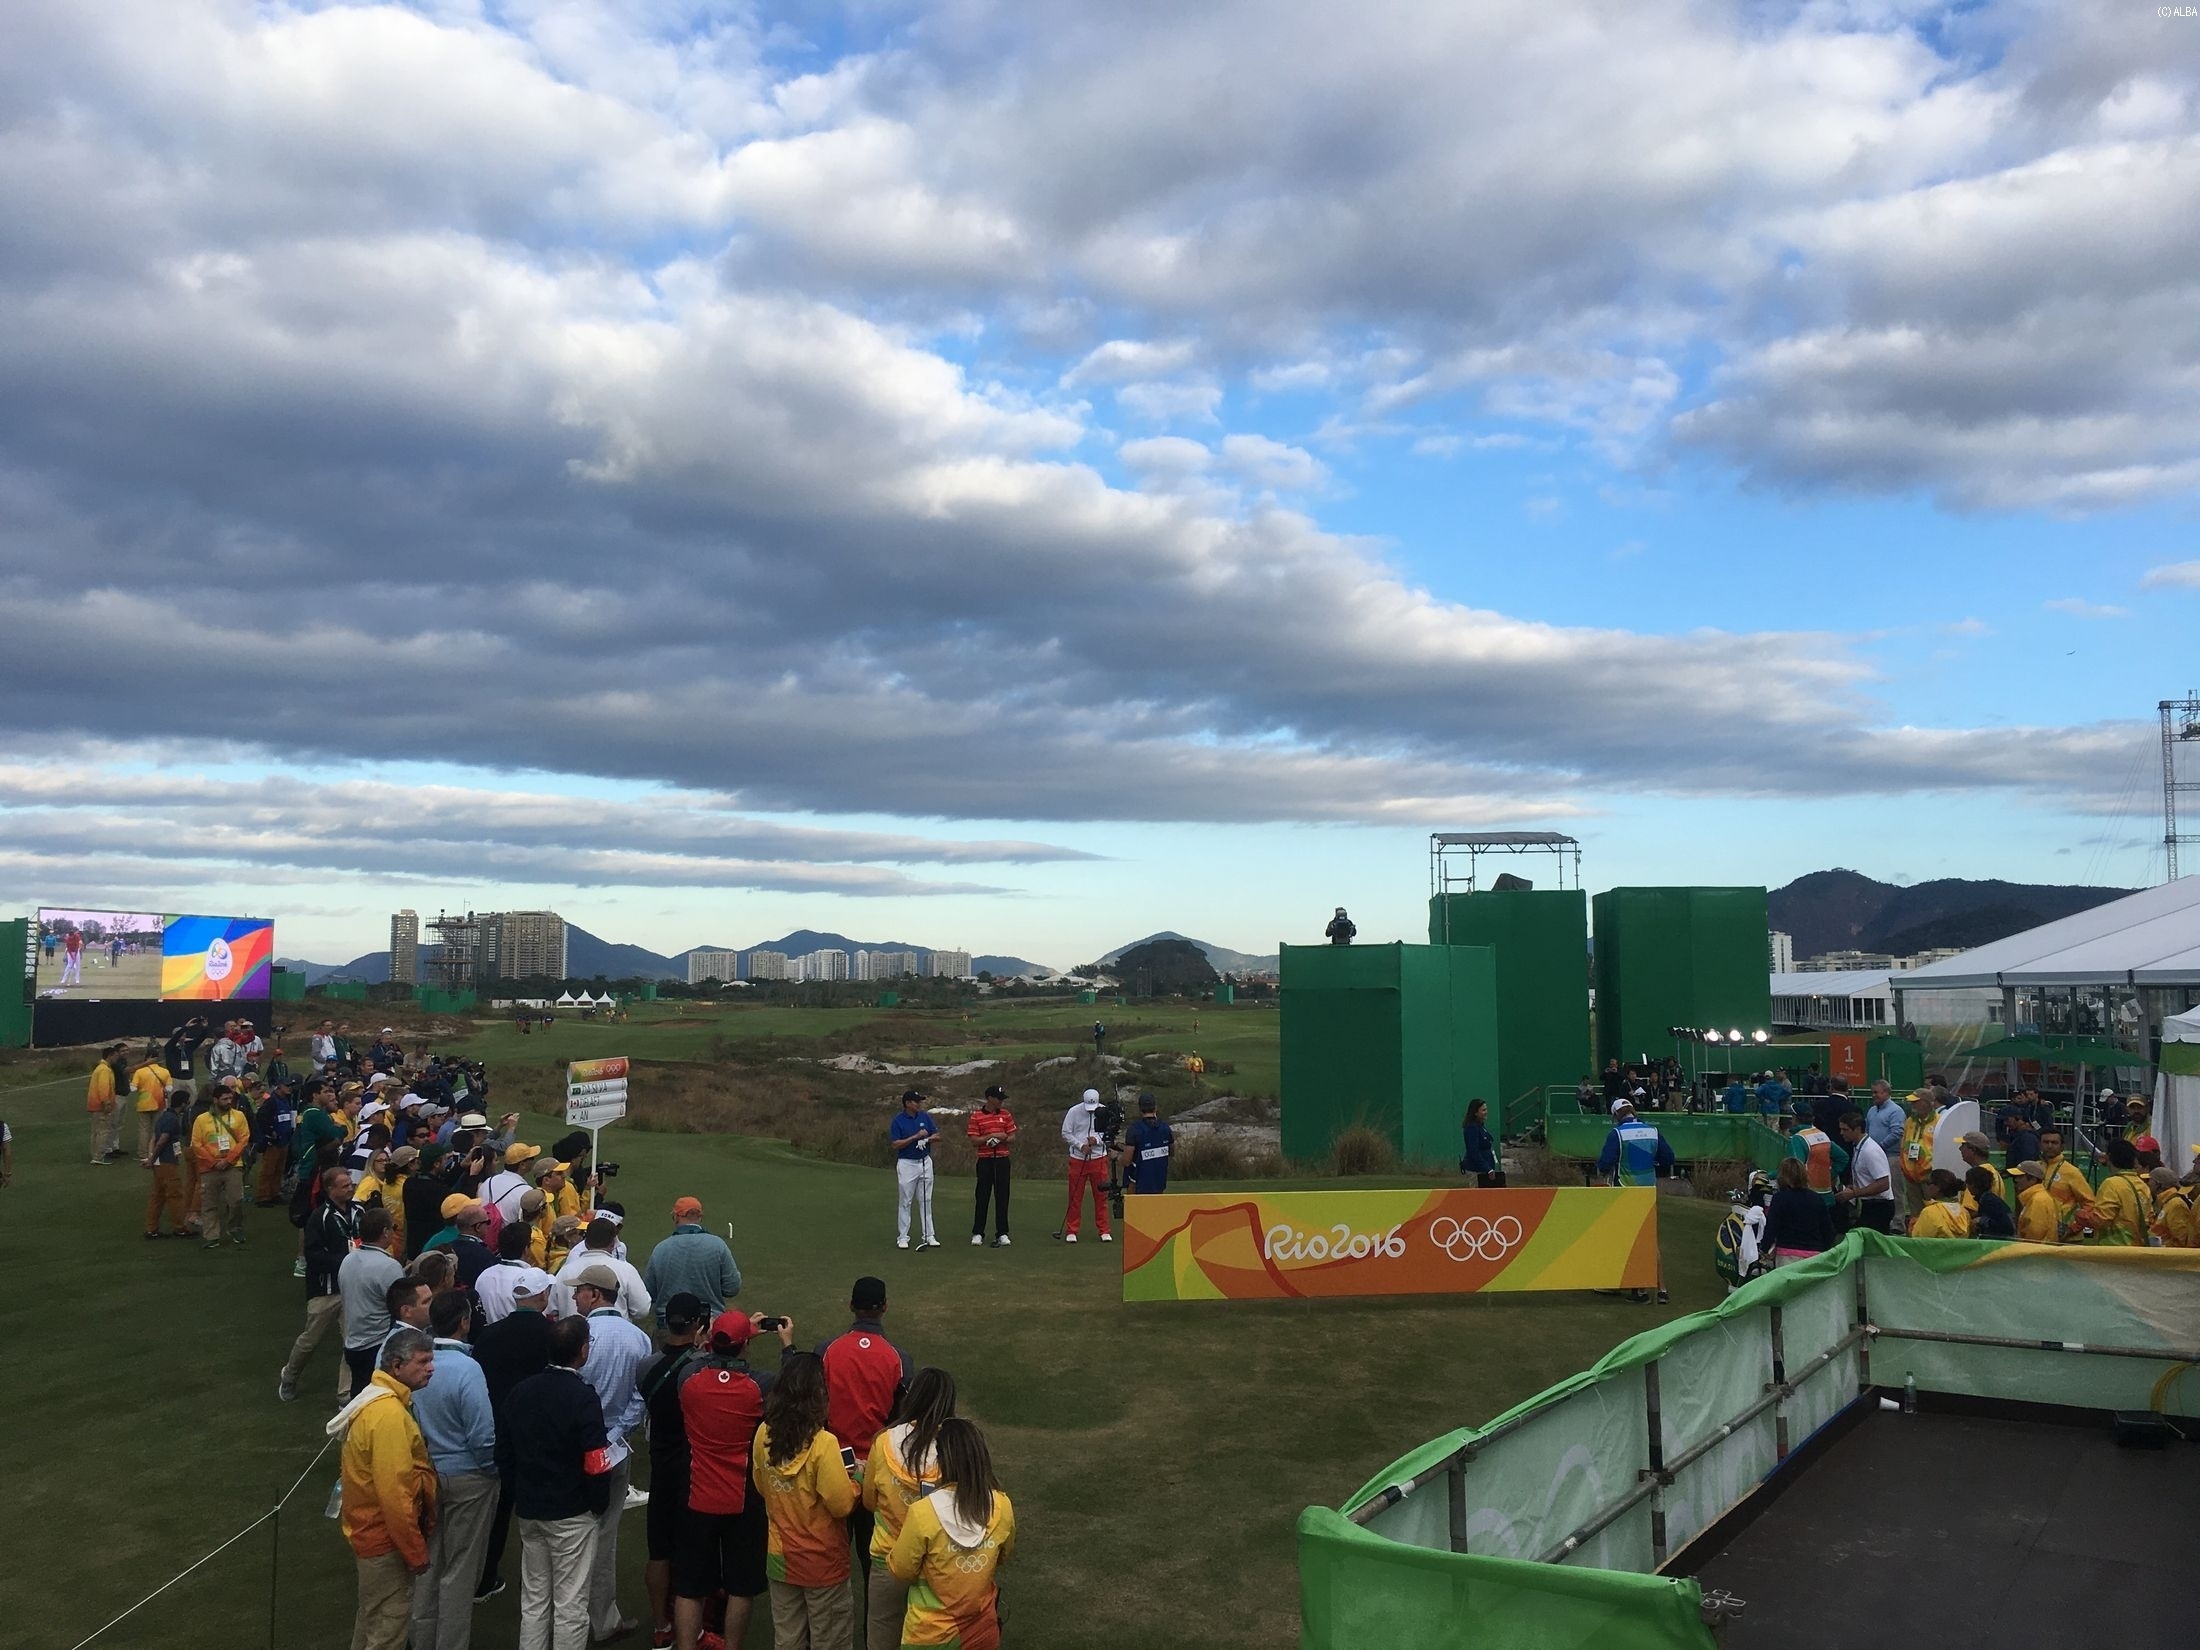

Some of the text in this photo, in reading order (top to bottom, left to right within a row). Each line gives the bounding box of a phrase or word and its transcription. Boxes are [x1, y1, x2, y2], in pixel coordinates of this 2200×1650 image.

[1844, 1045, 1854, 1062] 1
[580, 1110, 588, 1121] AN
[1264, 1223, 1406, 1261] Rio2016
